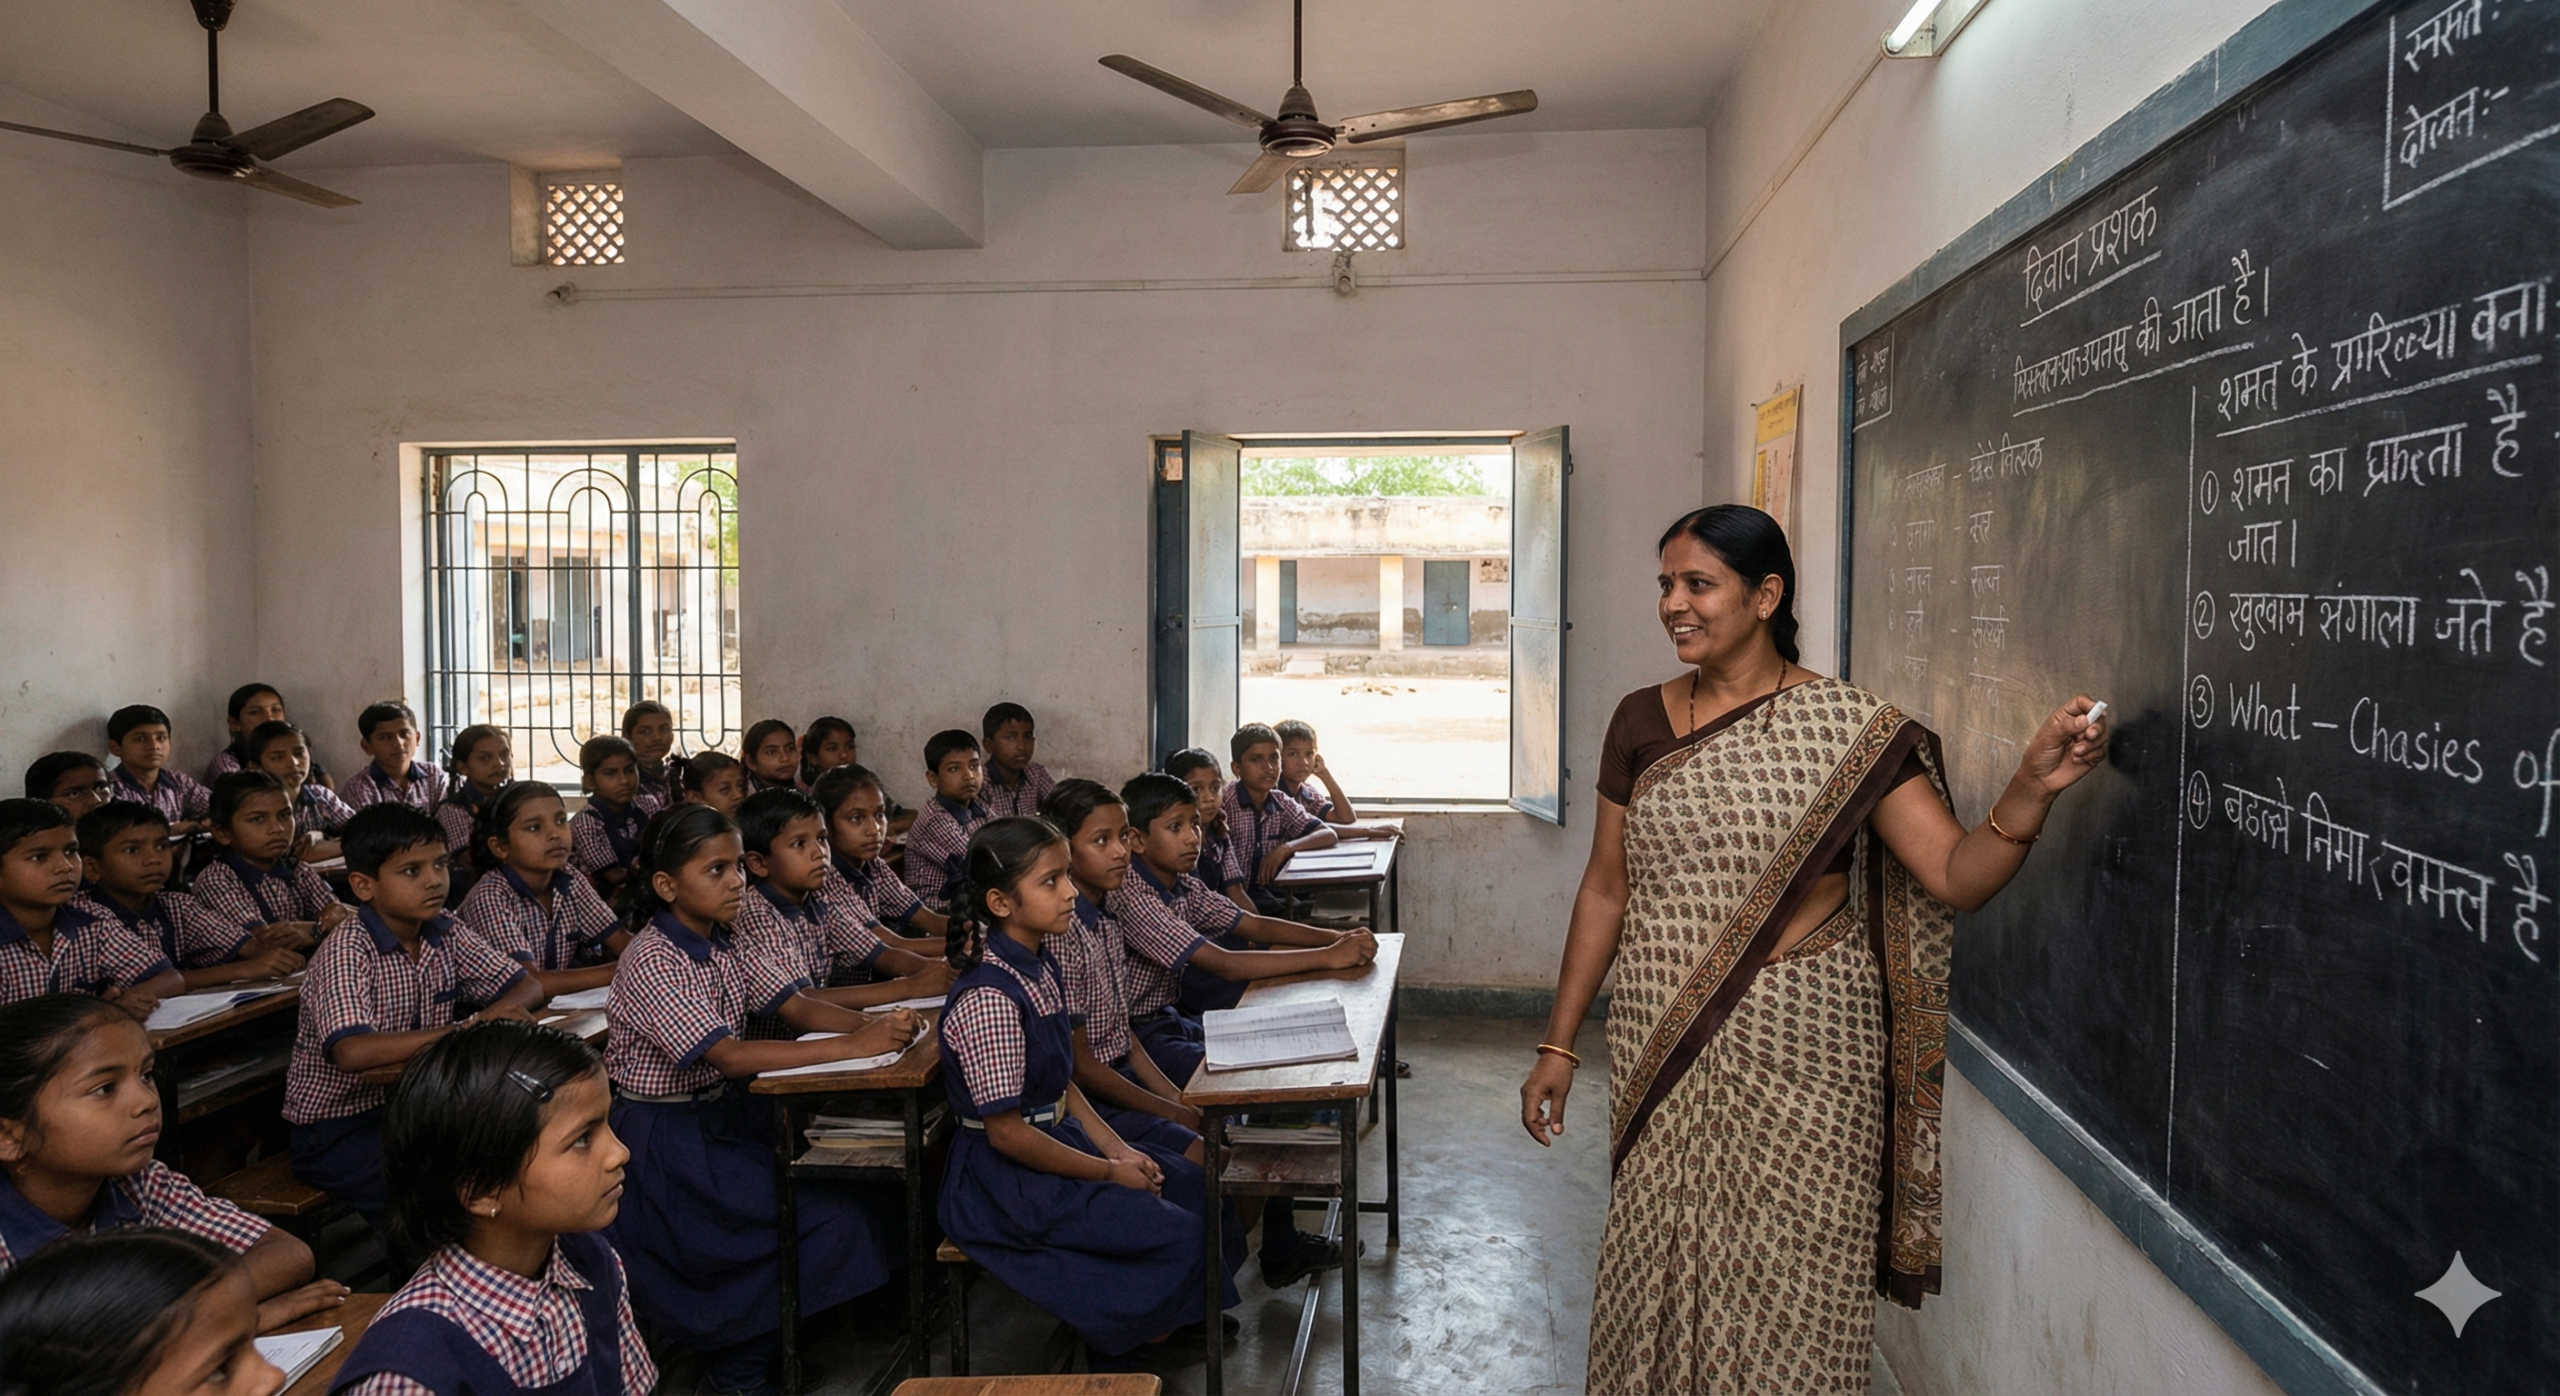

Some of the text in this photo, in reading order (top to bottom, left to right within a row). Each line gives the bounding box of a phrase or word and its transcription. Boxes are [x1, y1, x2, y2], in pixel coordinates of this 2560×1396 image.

[2136, 297, 2163, 357] की
[2168, 285, 2226, 344] जाता
[2291, 333, 2318, 395] के
[2309, 448, 2348, 496] का
[2486, 382, 2527, 477] है
[2515, 565, 2556, 667] है
[2229, 681, 2301, 740] What
[2350, 696, 2483, 784] Chasies
[2513, 727, 2560, 838] of
[2504, 852, 2551, 963] है
